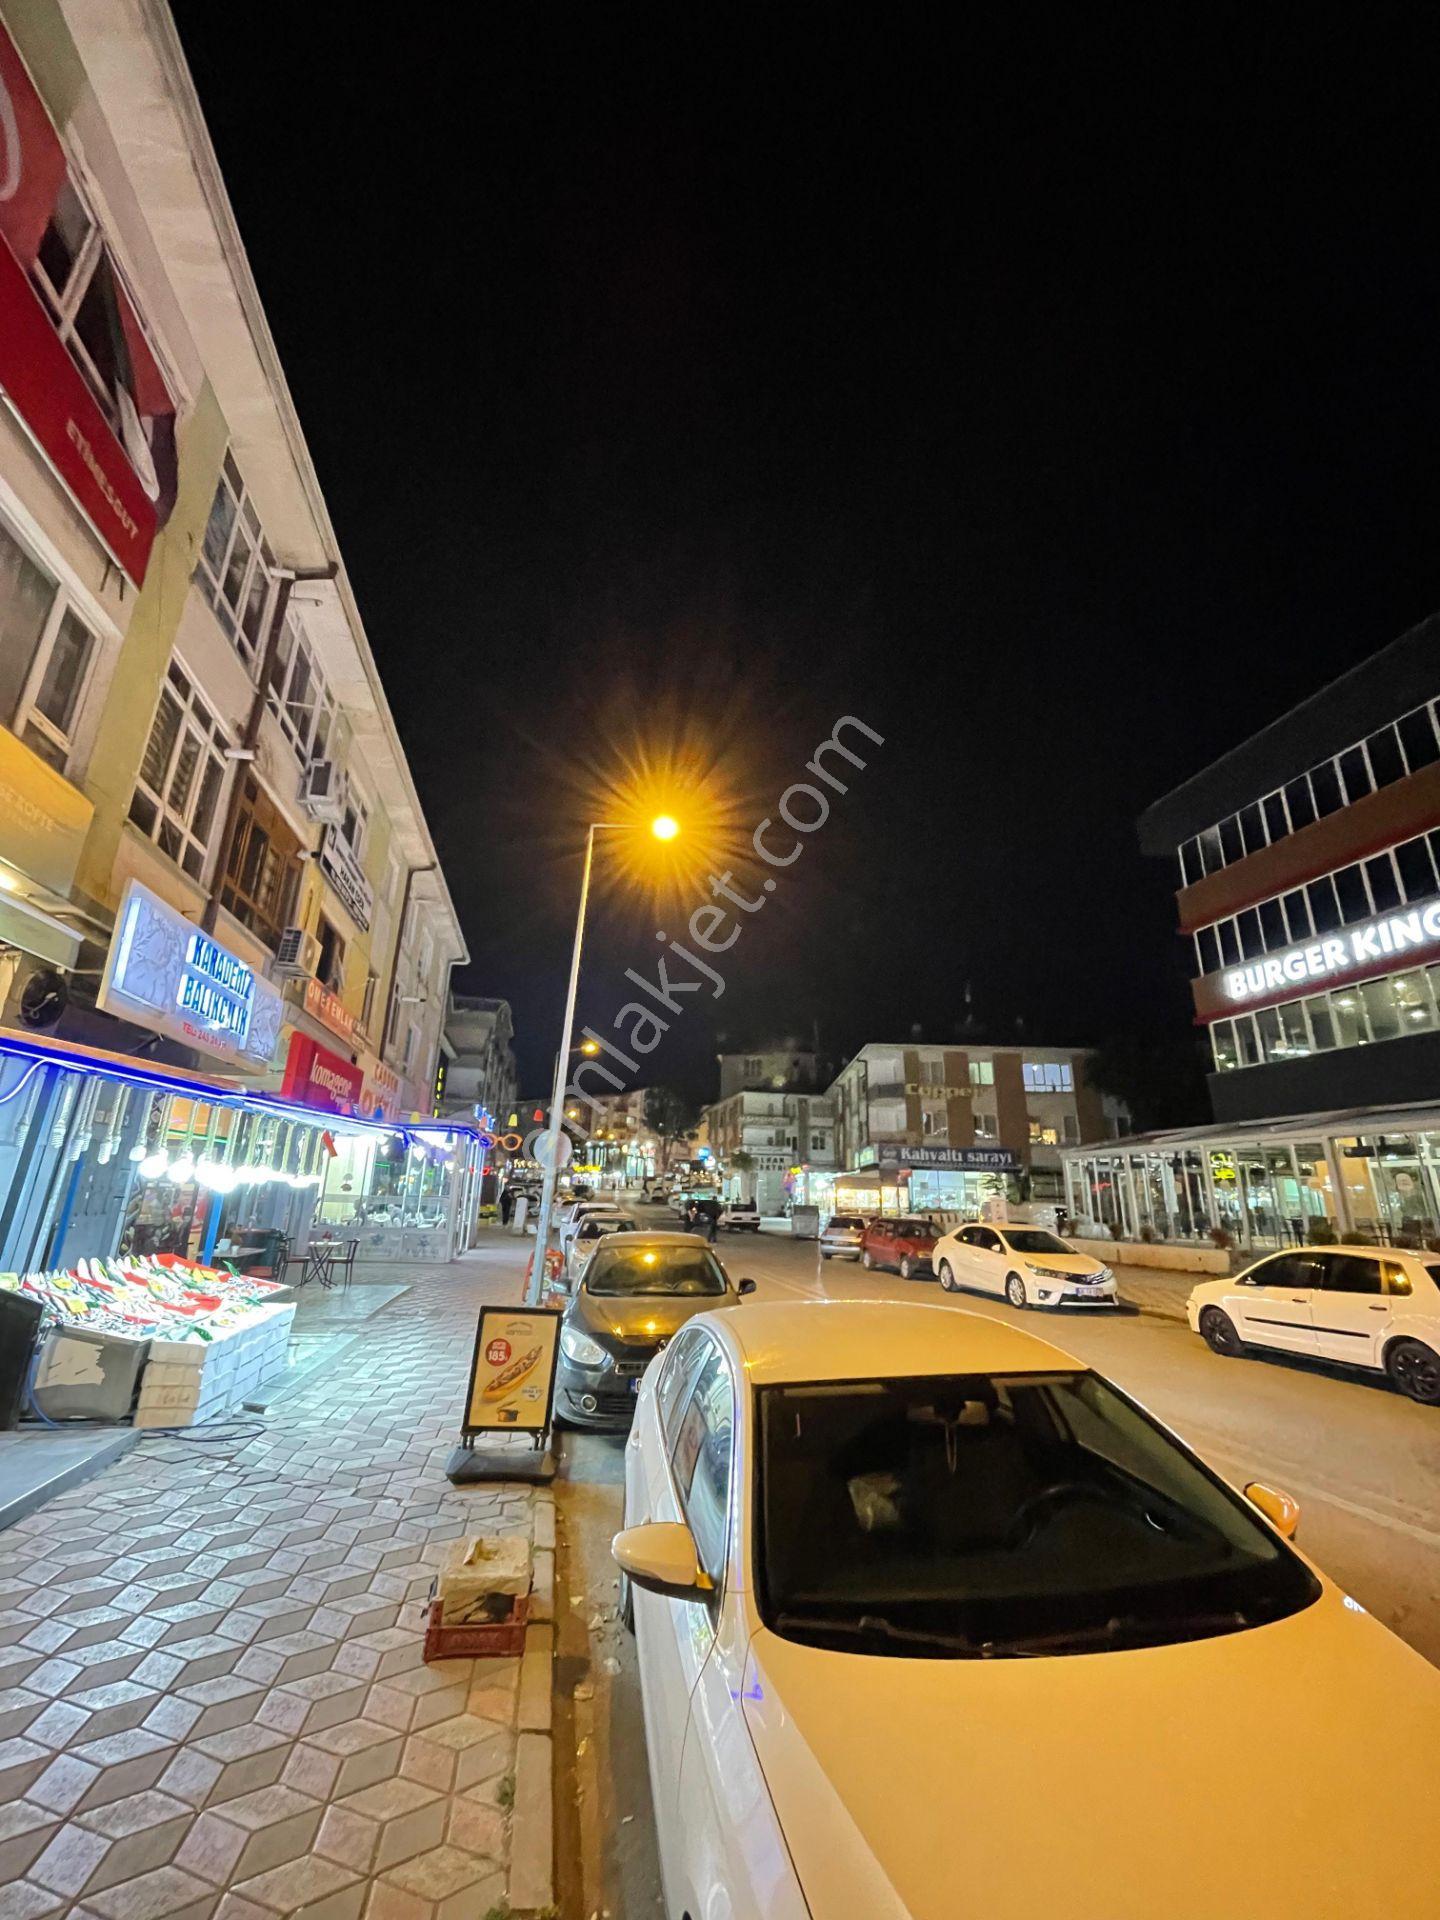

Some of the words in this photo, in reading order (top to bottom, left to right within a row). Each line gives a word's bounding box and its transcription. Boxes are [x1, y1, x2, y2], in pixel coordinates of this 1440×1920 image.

[1227, 938, 1349, 1000] BURGER
[1350, 903, 1440, 962] KING
[309, 1052, 353, 1101] komagene
[901, 1147, 963, 1161] Kahvaltı
[966, 1151, 1012, 1165] sarayı
